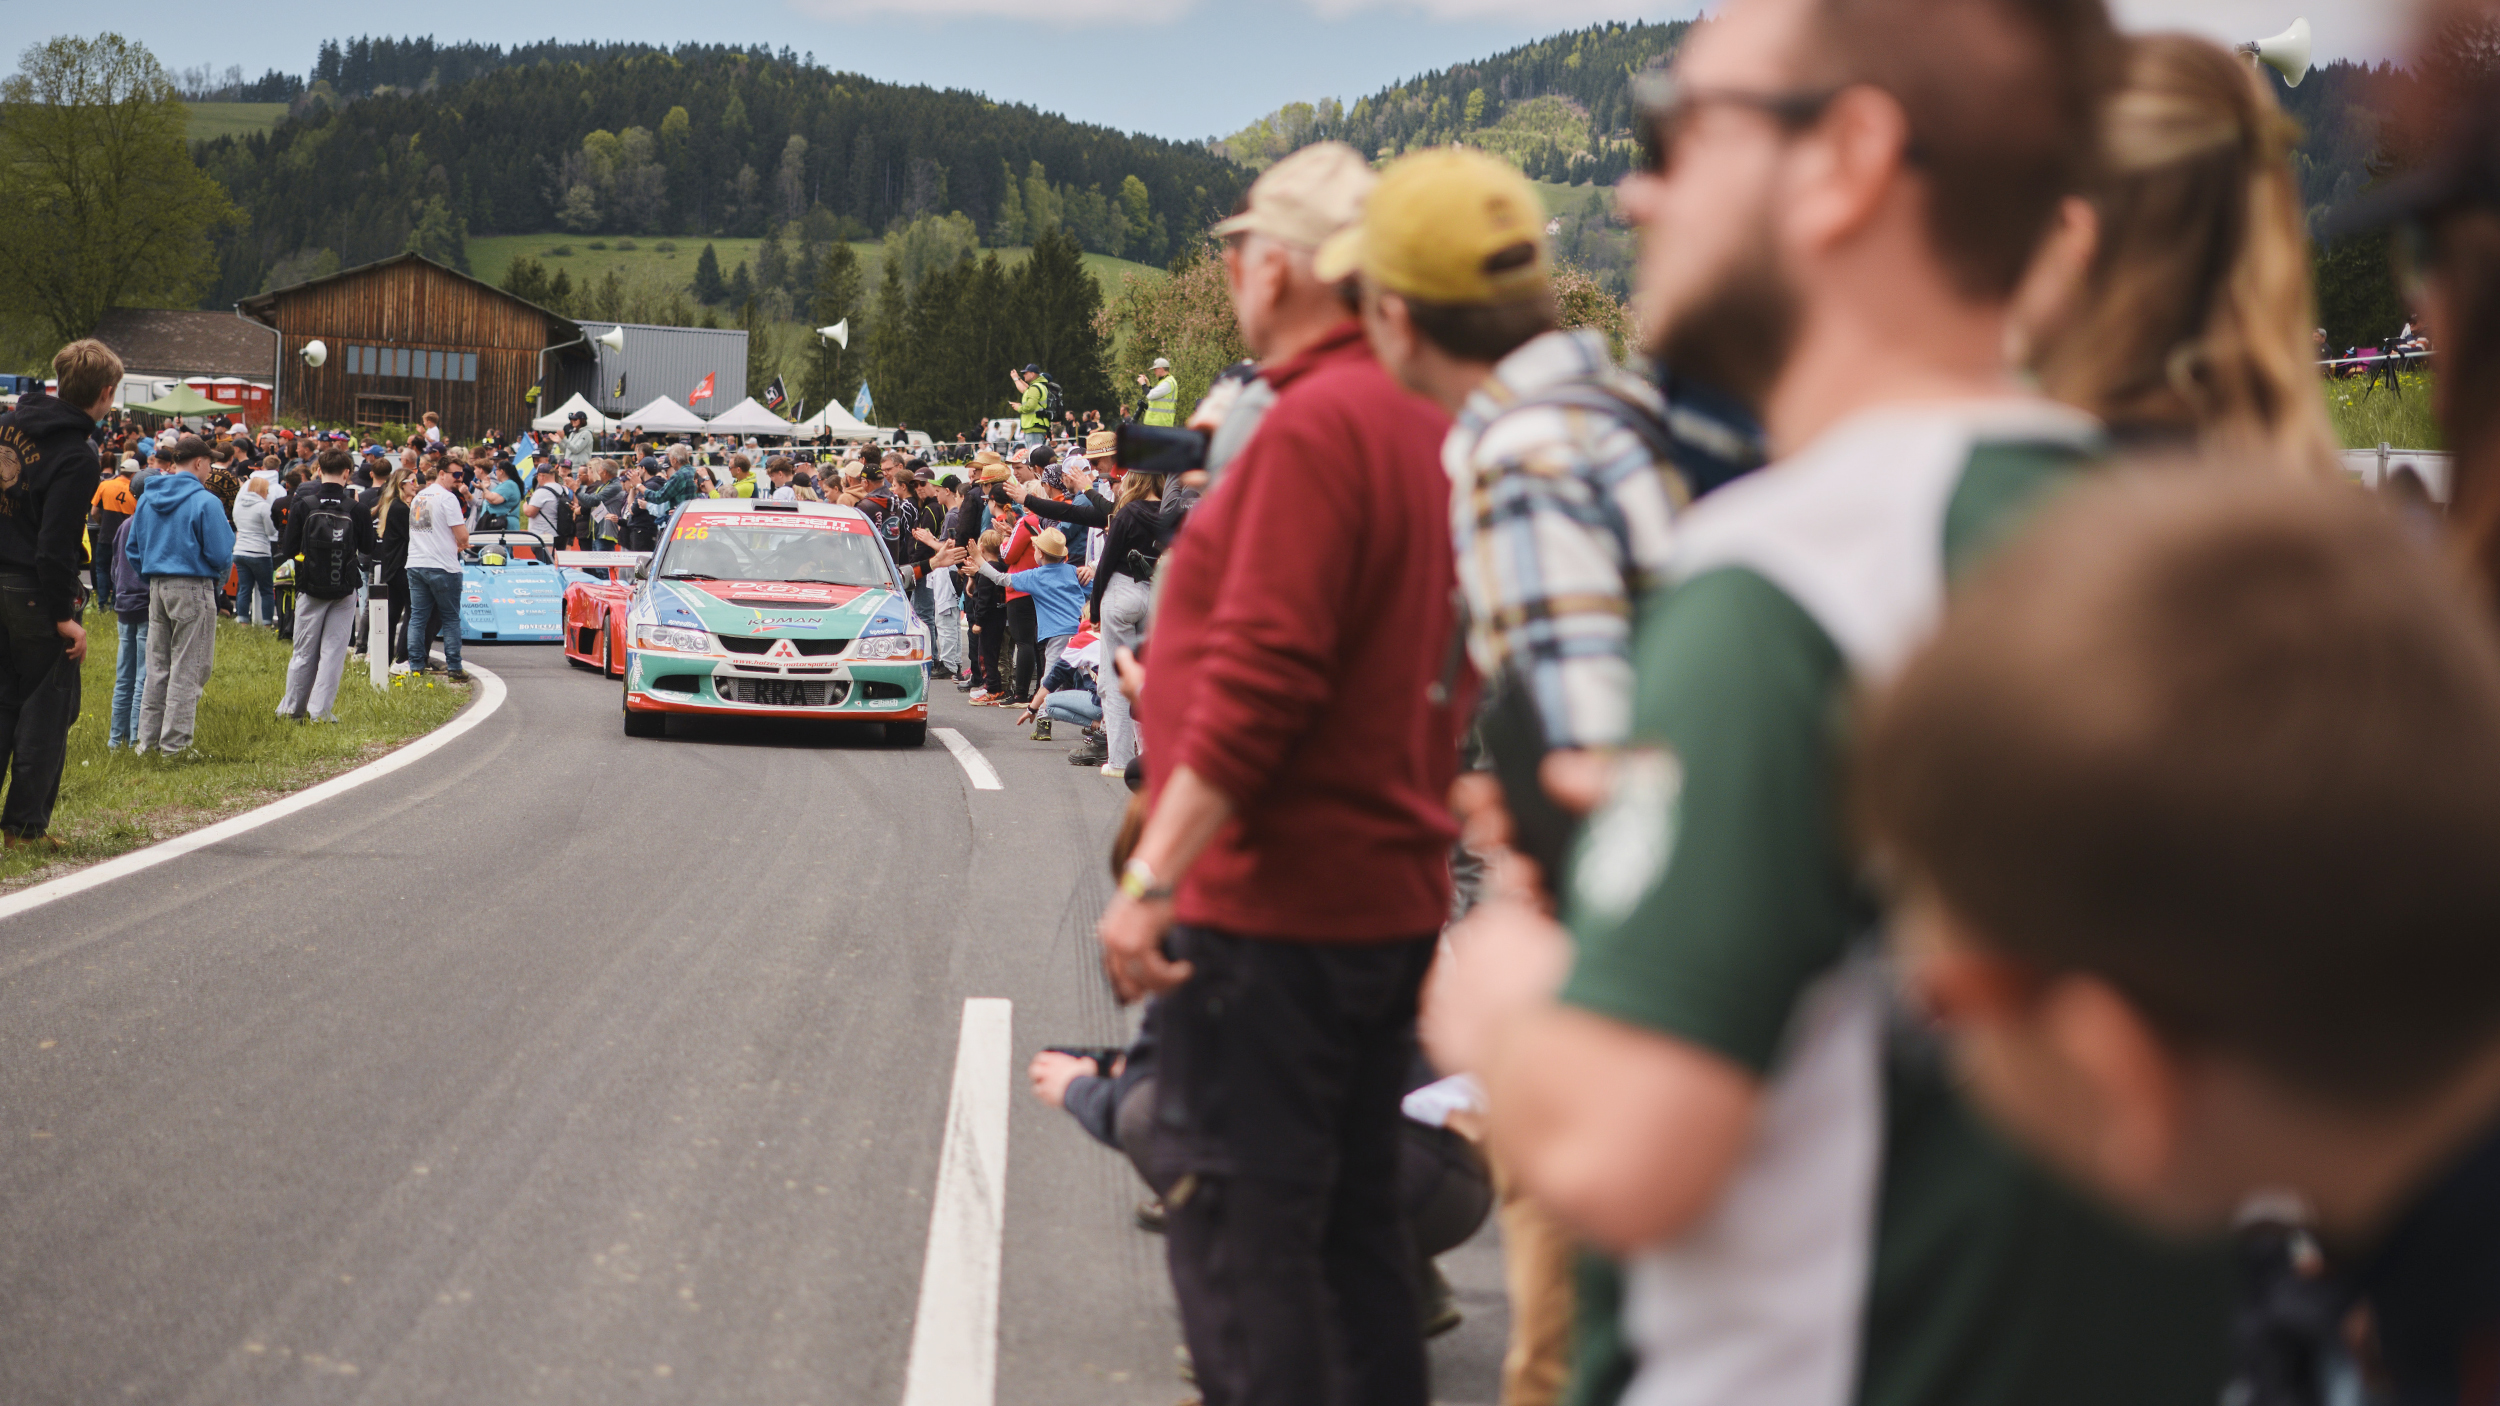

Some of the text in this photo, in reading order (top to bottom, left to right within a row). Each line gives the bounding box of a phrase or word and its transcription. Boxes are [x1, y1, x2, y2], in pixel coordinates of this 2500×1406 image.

[0, 426, 41, 465] ICKIES
[115, 491, 126, 504] 4
[675, 526, 709, 540] 126
[747, 617, 823, 626] KOMAN
[754, 679, 808, 706] RRA
